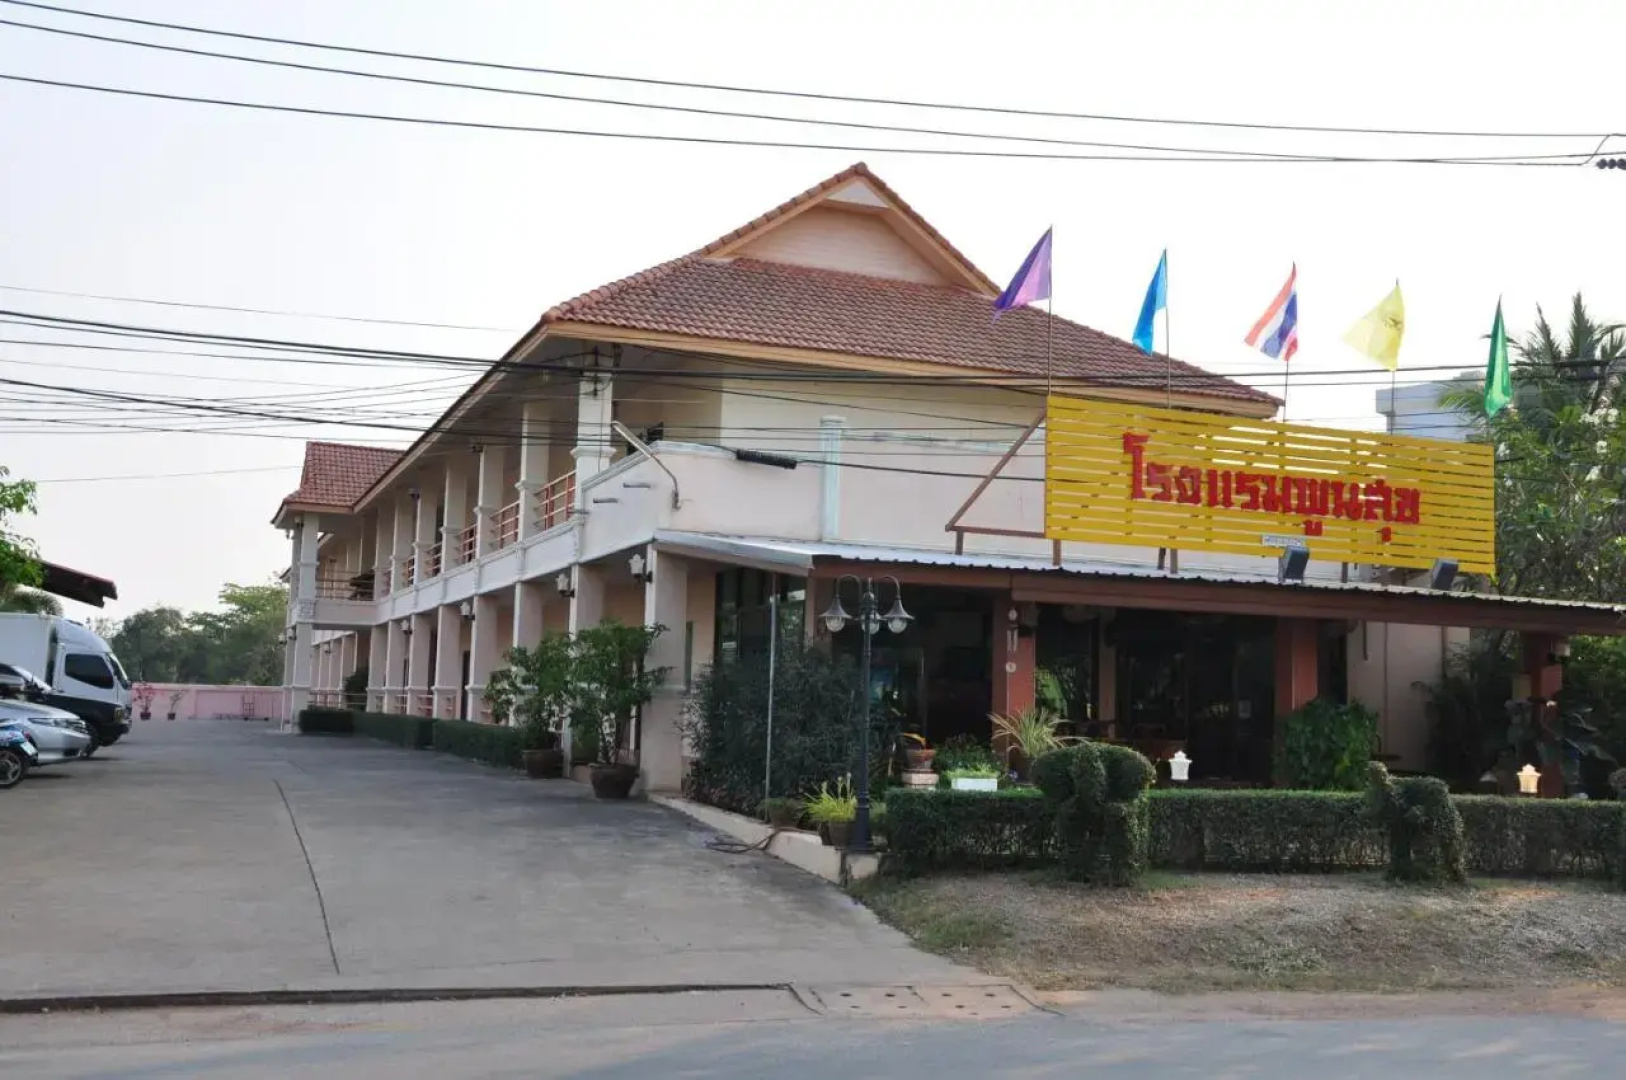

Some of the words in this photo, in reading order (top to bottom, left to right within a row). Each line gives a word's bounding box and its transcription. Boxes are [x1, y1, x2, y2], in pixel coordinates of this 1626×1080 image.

[1122, 432, 1420, 542] โรงแรมพูนสุข
